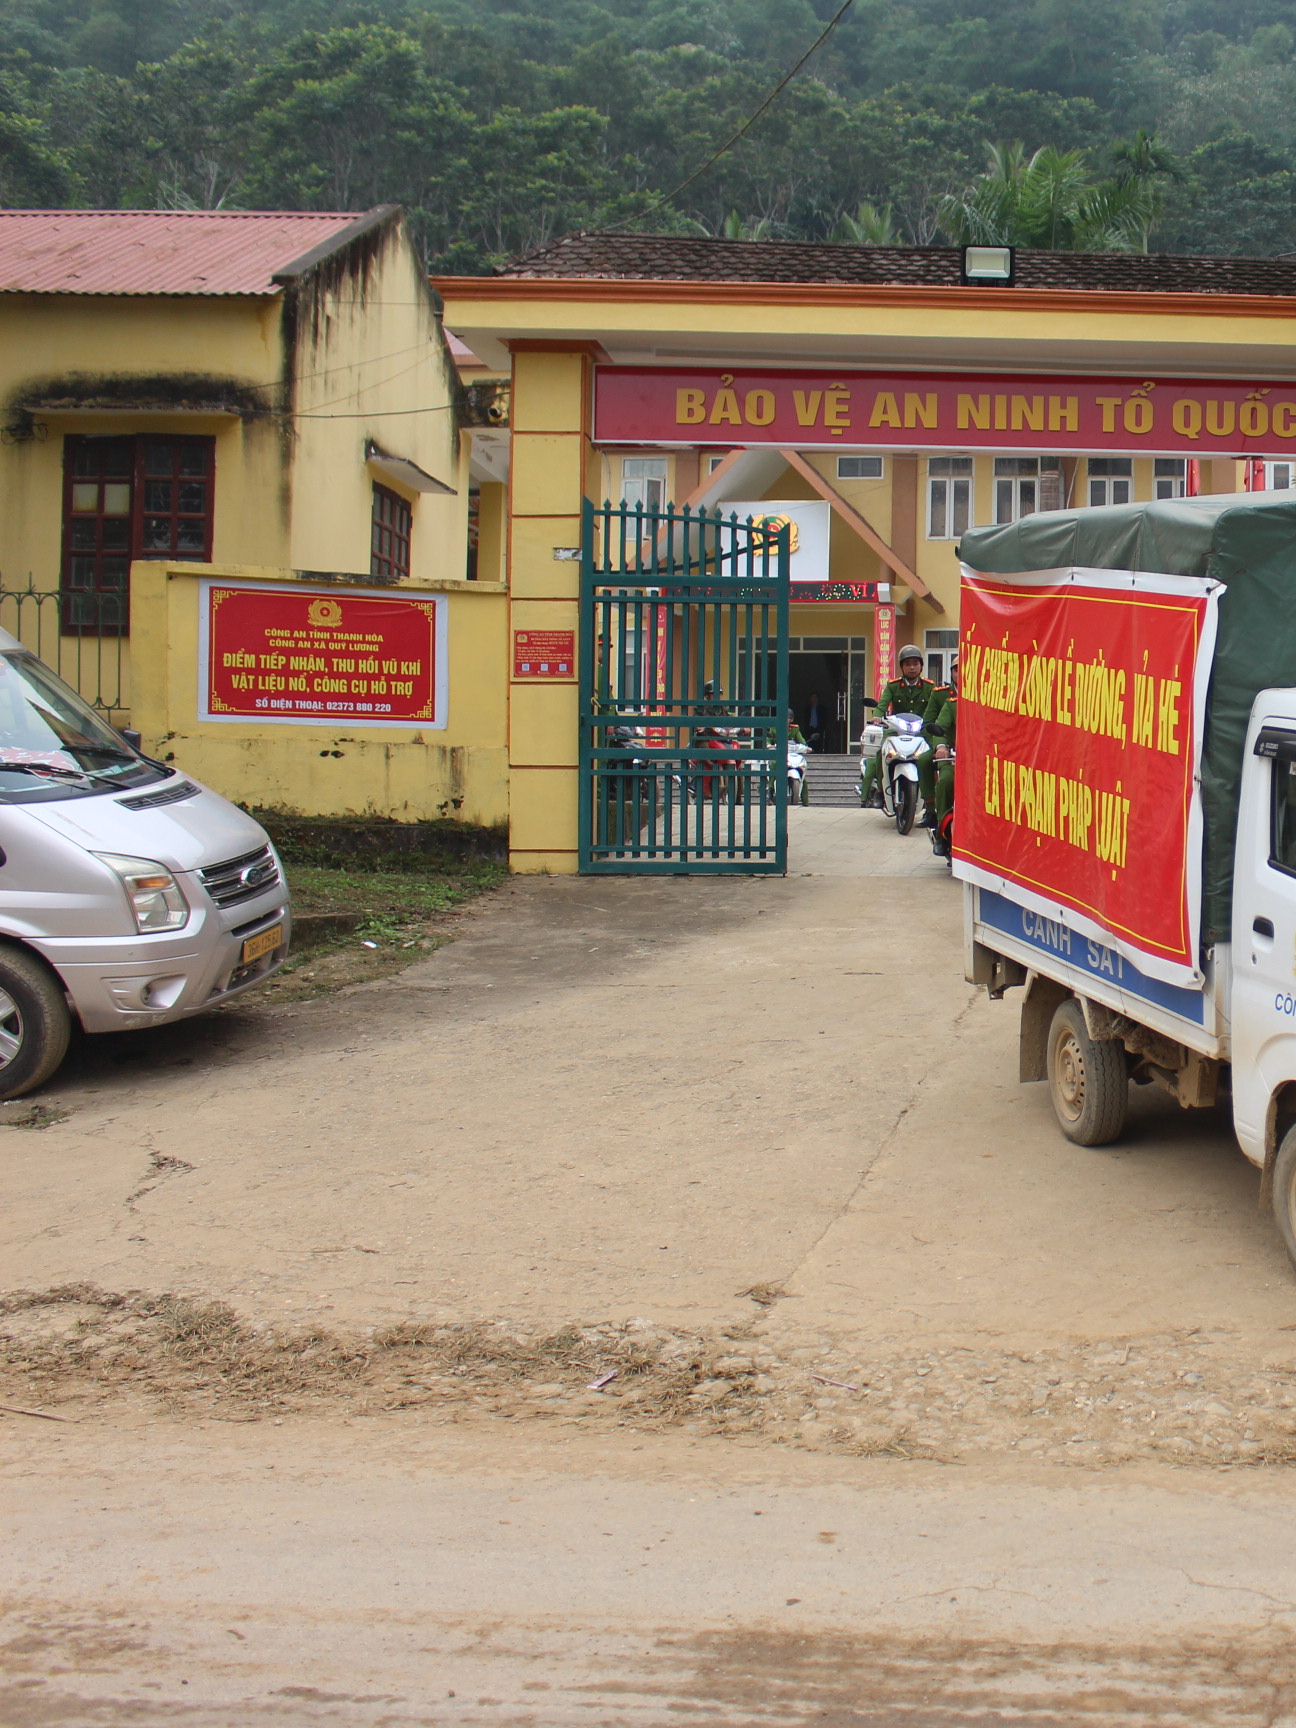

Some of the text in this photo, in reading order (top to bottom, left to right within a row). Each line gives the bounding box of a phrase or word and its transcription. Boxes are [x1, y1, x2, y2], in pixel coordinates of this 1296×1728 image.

[675, 373, 777, 426] BẢO
[793, 382, 851, 435] VỆ
[868, 392, 938, 429] AN
[956, 393, 1079, 432] NINH
[1096, 381, 1156, 434] TỔ
[265, 628, 291, 637] CÔNG
[293, 630, 306, 638] AN
[333, 632, 363, 641] THANH
[365, 632, 384, 642] HÓA
[269, 638, 295, 648] CÔNG
[298, 640, 311, 649] AN
[313, 640, 326, 649] XÃ
[349, 643, 379, 652] LƯƠNG
[223, 648, 256, 668] ĐIỂM
[259, 651, 287, 670] TIẾP
[290, 654, 329, 674] NHẬN,
[332, 657, 355, 673] THU
[382, 657, 398, 675] VŨ
[400, 659, 421, 676] KHÍ
[231, 671, 256, 692] VẬT
[258, 673, 285, 693] LIỆU
[289, 671, 310, 693] NỔ,
[313, 675, 348, 693] CÔNG
[351, 680, 367, 697] CỤ
[390, 681, 414, 699] TRỢ
[980, 631, 1019, 713] CHIẾM
[1019, 639, 1056, 721] LÒNG
[1075, 648, 1126, 750] ĐƯỜNG,
[1132, 649, 1154, 749] VỈA
[256, 696, 269, 708] SỐ
[270, 698, 293, 710] ĐIỆN
[295, 700, 324, 711] THOẠI:
[326, 701, 354, 711] 02373
[374, 703, 391, 712] 220
[985, 744, 1131, 881] LÀ VI PHẠM PHÁP LUẬT
